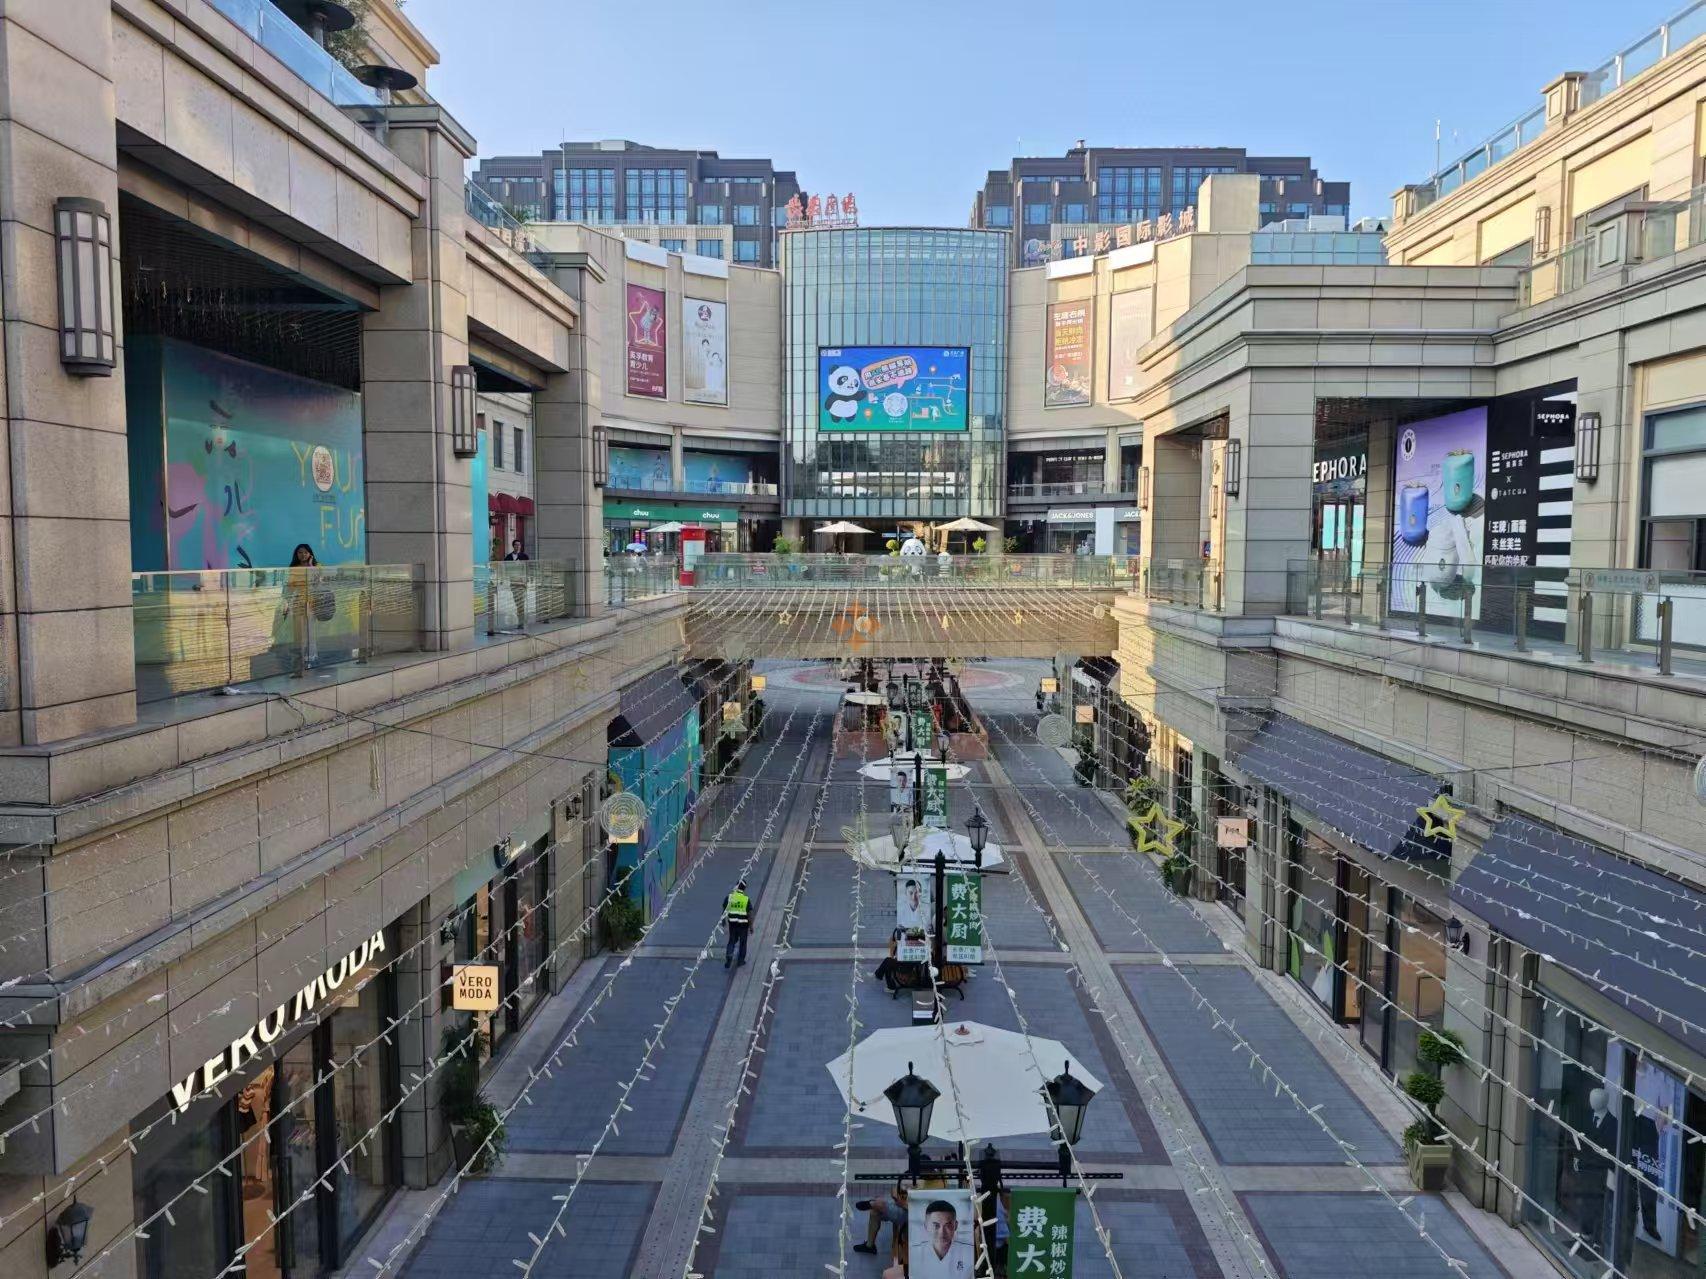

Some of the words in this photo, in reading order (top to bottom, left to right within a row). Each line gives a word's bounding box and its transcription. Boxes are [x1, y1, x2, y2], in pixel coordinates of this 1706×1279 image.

[1073, 205, 1195, 256] 中影国际影城
[1502, 450, 1528, 460] SEPHORA
[1313, 453, 1367, 483] EPHORA
[633, 509, 649, 517] chuu
[702, 511, 720, 519] chuu
[1051, 512, 1094, 520] JACK&JONES
[1491, 538, 1522, 551] 来丝芙兰
[951, 882, 968, 940] 费大厨
[460, 976, 492, 987] VERO
[459, 988, 492, 999] MODA
[1016, 1205, 1048, 1273] 费大
[1050, 1224, 1068, 1279] 辣椒炒
